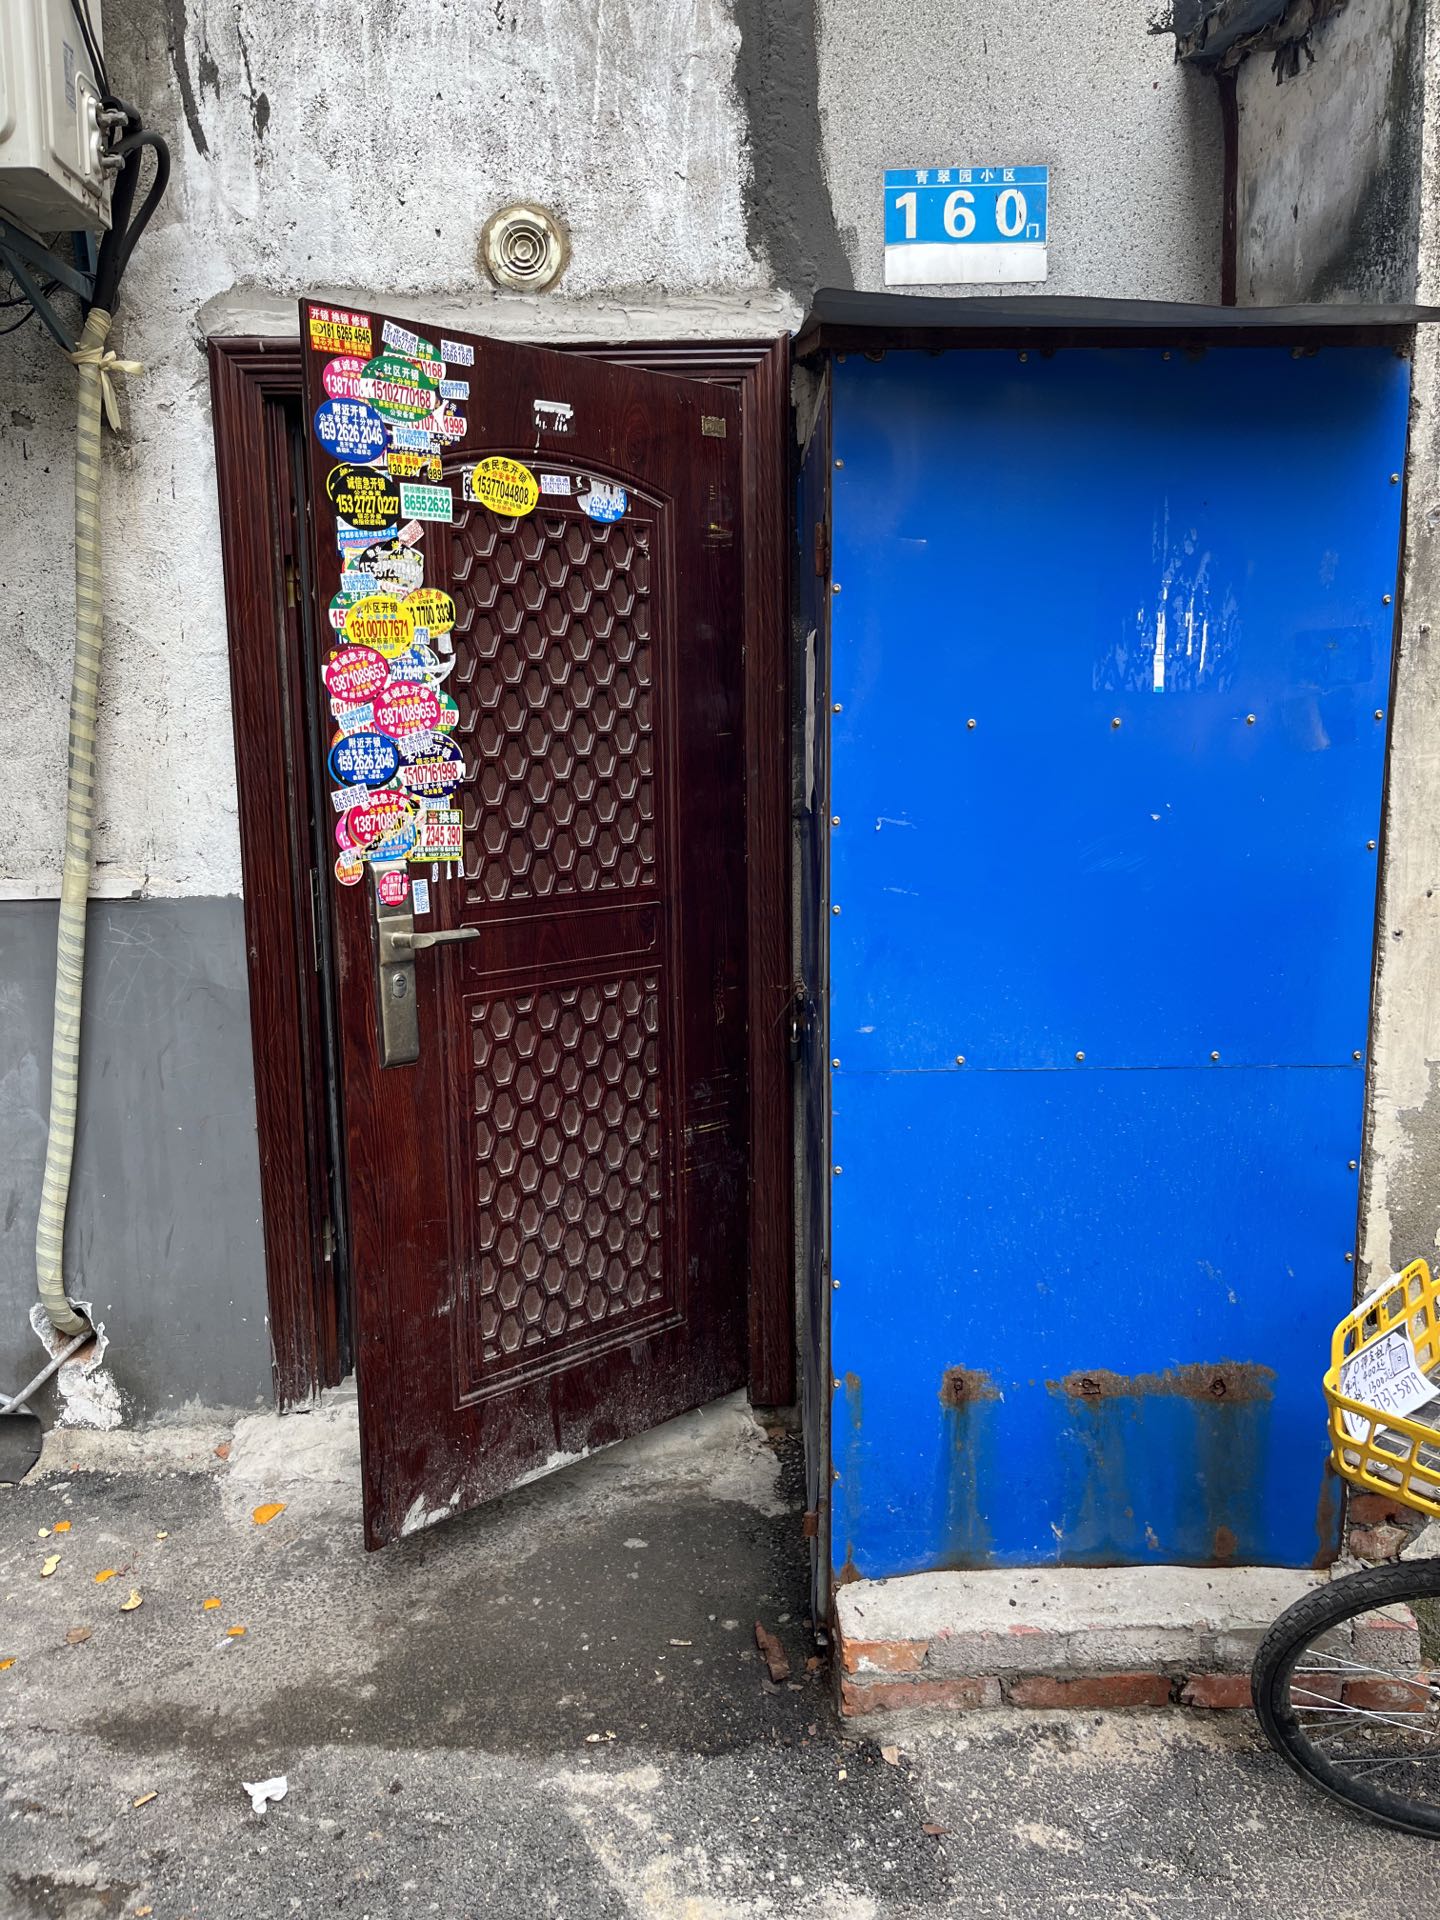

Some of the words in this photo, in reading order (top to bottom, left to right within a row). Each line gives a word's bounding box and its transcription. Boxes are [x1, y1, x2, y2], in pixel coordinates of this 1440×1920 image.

[915, 168, 1016, 185] 青翠园小区
[895, 189, 1027, 239] 160
[1026, 223, 1040, 239] 门
[311, 308, 329, 321] 开锁
[332, 312, 349, 325] 换锁
[351, 315, 369, 328] 修锁
[323, 323, 335, 338] 181
[337, 325, 353, 341] 6265
[384, 363, 420, 381] 社区开锁
[371, 381, 432, 409] 15102770168
[319, 413, 349, 424] 公安备案
[352, 417, 381, 428] 十分钟到
[332, 403, 368, 419] 附近开锁
[319, 422, 336, 441] 159
[337, 424, 360, 443] 2626
[361, 427, 384, 445] 2046
[389, 463, 402, 475] 130
[482, 459, 528, 483] 便民急开锁
[347, 476, 386, 491] 诚信急开锁
[478, 475, 529, 505] 15377044808
[336, 495, 354, 513] 153
[355, 495, 376, 514] 2727
[378, 496, 399, 515] 0227
[404, 495, 451, 514] 86552632
[364, 602, 398, 614] 小区开锁
[351, 620, 365, 638] 131
[367, 620, 388, 638] 0070
[390, 619, 409, 637] 7671
[329, 662, 387, 693] 13871089653
[377, 701, 438, 726] 13871089653
[348, 737, 381, 749] 附近开锁
[338, 755, 353, 772] 159
[354, 754, 374, 771] 2626
[375, 753, 395, 770] 2046
[403, 761, 458, 785] 15107161998
[439, 811, 460, 824] 换锁
[426, 826, 445, 846] 2345
[447, 826, 461, 846] 390
